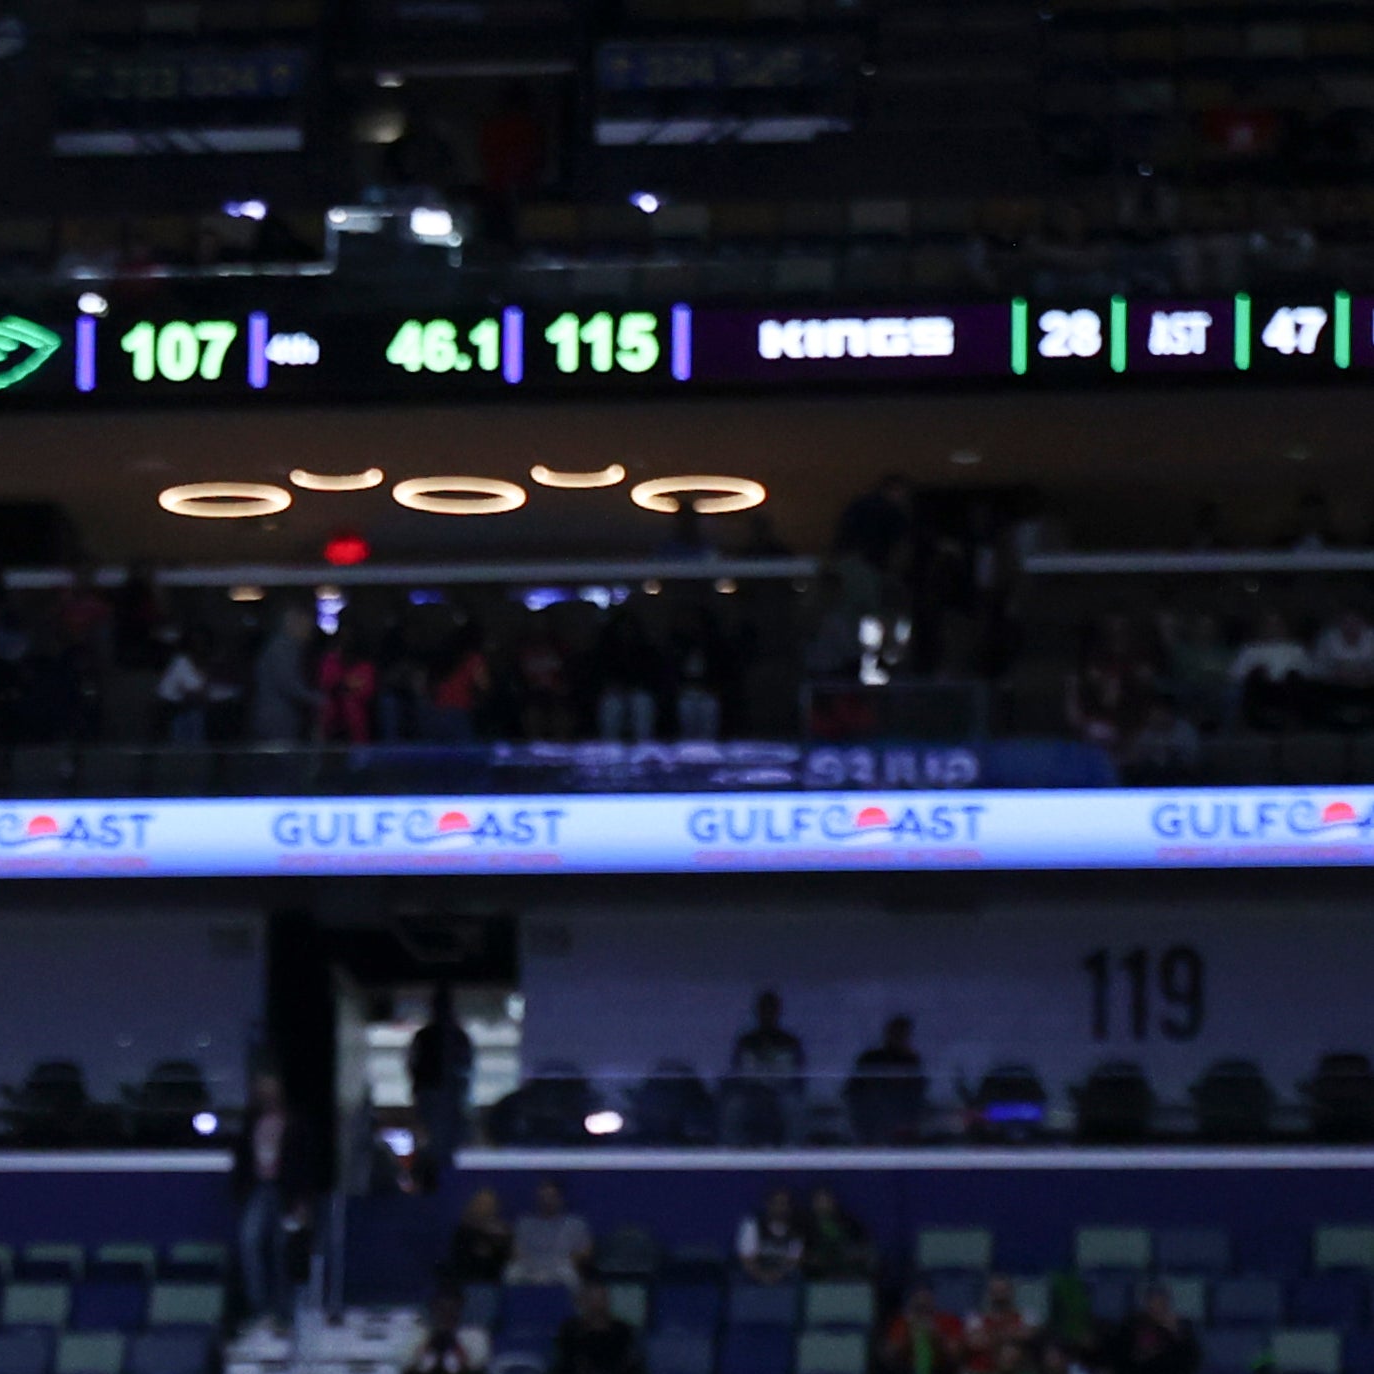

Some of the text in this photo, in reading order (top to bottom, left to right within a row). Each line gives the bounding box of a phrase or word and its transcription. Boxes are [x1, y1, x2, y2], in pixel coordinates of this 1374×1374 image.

[121, 321, 238, 381] 107
[386, 318, 500, 373] 46.1
[545, 312, 660, 373] 115
[1262, 306, 1327, 354] 47
[271, 808, 566, 846] GULFCOAST
[687, 805, 987, 844] GULFCOAST
[1152, 799, 1374, 840] GULFCO
[1082, 944, 1208, 1041] 119
